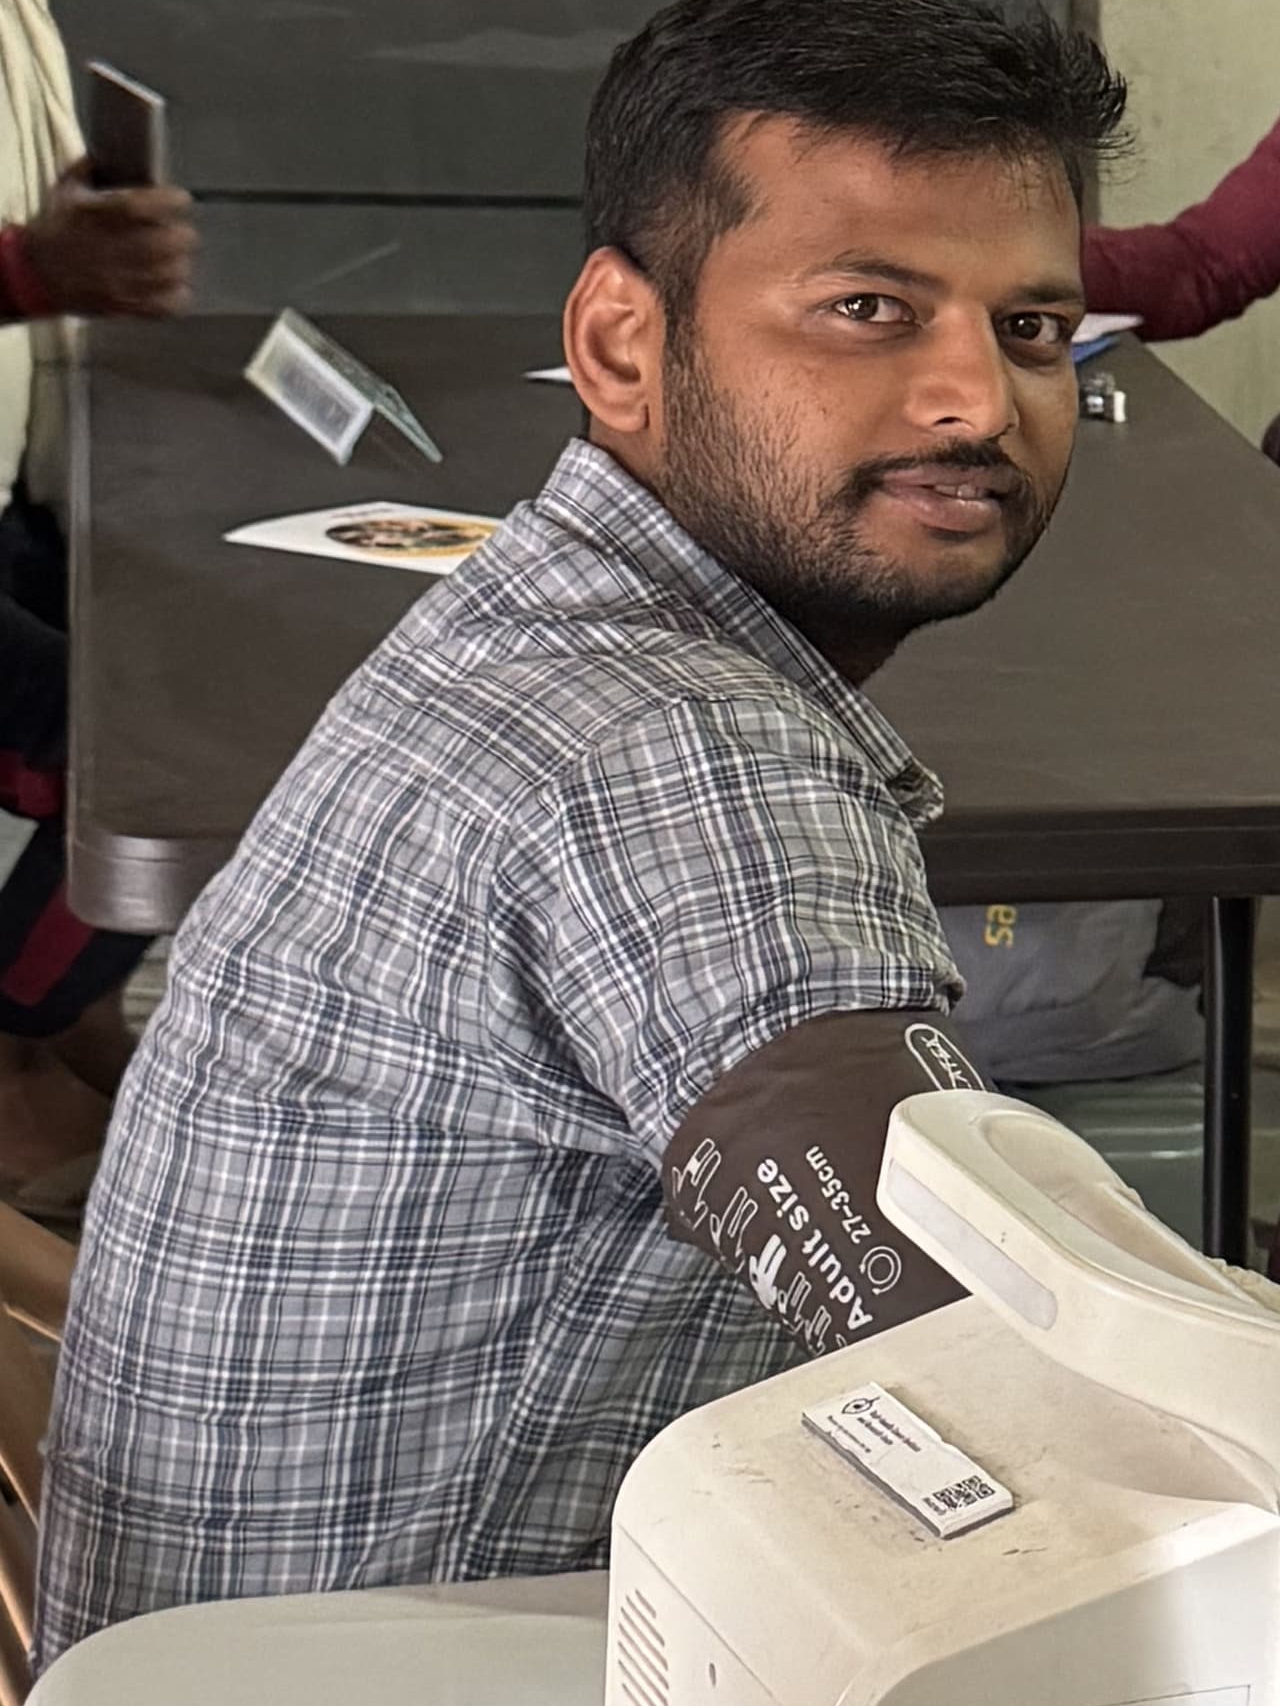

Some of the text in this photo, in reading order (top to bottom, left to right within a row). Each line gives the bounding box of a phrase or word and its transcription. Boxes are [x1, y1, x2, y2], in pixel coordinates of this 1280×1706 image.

[756, 1158, 874, 1332] Adult size
[805, 1145, 871, 1245] 27-35cm
